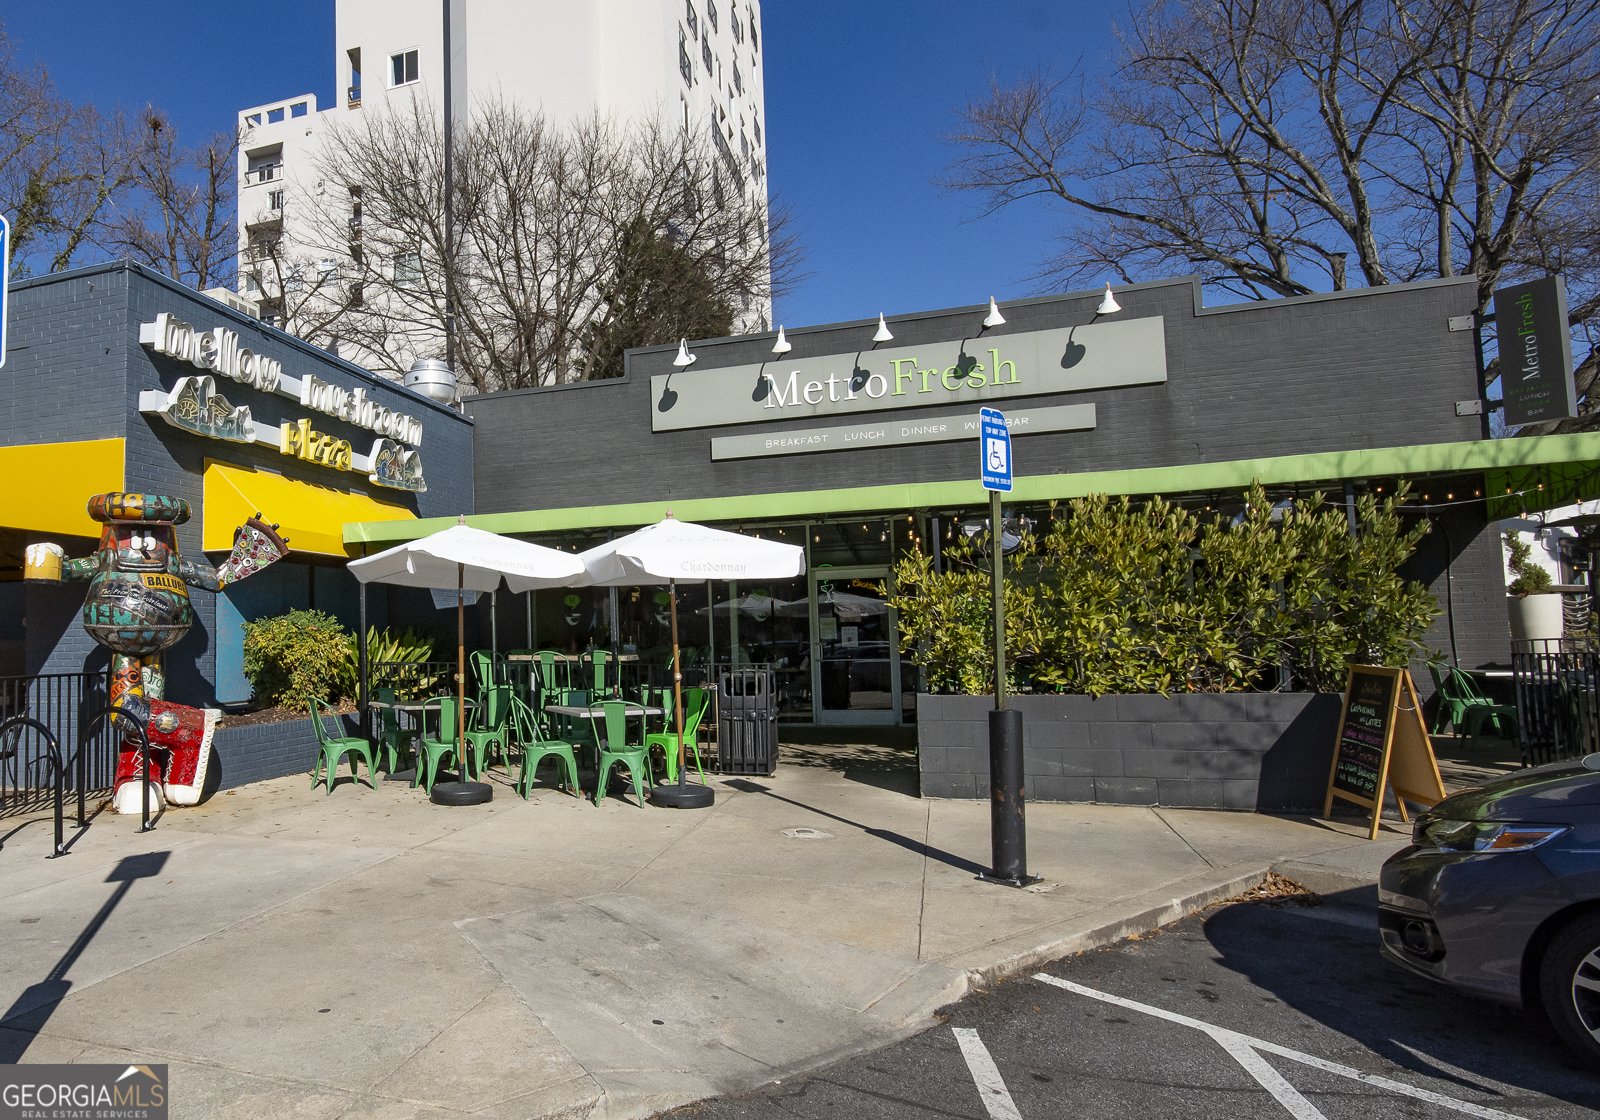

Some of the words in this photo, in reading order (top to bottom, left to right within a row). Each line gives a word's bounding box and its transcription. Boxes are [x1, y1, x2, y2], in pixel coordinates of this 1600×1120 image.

[1515, 292, 1541, 381] MetroFresh
[154, 312, 281, 392] mellow
[300, 374, 423, 446] mushroom
[763, 348, 1022, 409] MetroFresh
[1519, 391, 1550, 401] LUNCH
[765, 434, 829, 449] BREAKFAST
[844, 429, 885, 441] LUNCH
[901, 424, 947, 437] DINNER
[964, 421, 979, 431] WI
[1006, 417, 1029, 427] BAR
[680, 559, 747, 575] Chardonnay
